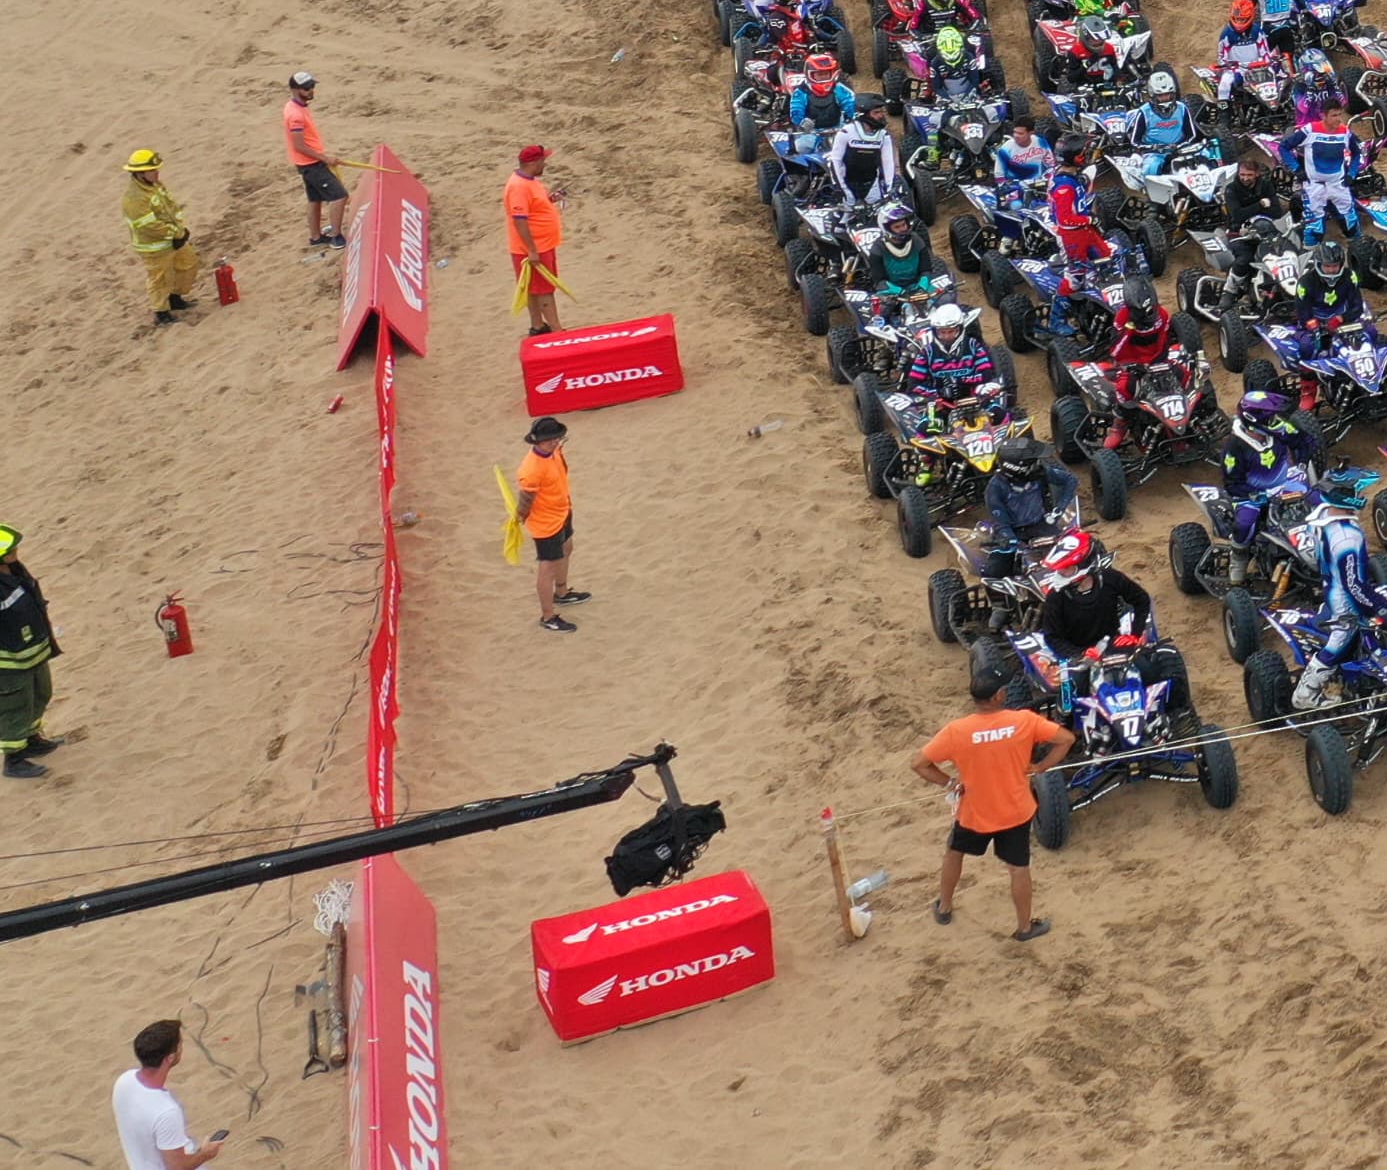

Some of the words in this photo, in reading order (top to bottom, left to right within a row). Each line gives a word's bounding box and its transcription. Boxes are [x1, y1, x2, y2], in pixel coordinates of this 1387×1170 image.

[401, 199, 423, 290] HONDA
[1354, 358, 1374, 373] 50
[564, 365, 663, 391] HONDA
[885, 394, 910, 410] 120
[1161, 400, 1185, 416] 114
[966, 439, 991, 458] 120
[1201, 488, 1219, 500] 23
[972, 726, 1015, 743] STAFF
[1121, 717, 1139, 737] 17
[601, 893, 738, 936] HONDA
[618, 944, 755, 998] HONDA
